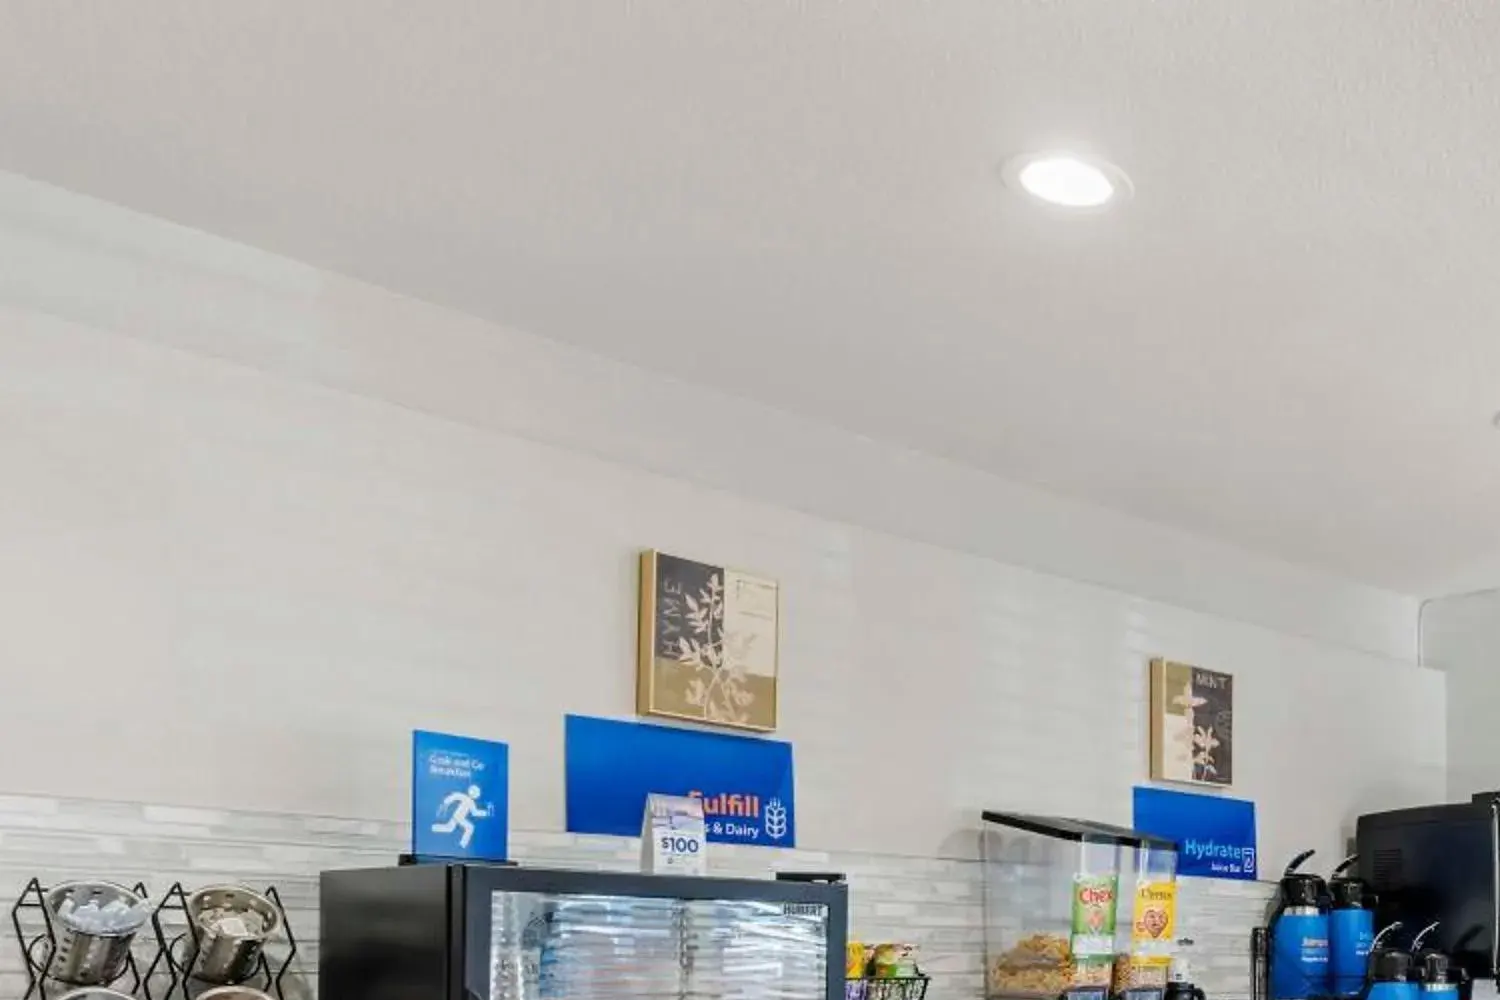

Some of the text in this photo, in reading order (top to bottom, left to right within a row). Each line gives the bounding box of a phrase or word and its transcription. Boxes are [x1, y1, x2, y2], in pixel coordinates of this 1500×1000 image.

[725, 824, 760, 839] Dairy
[661, 838, 699, 854] $100
[1185, 839, 1241, 860] Hydrate
